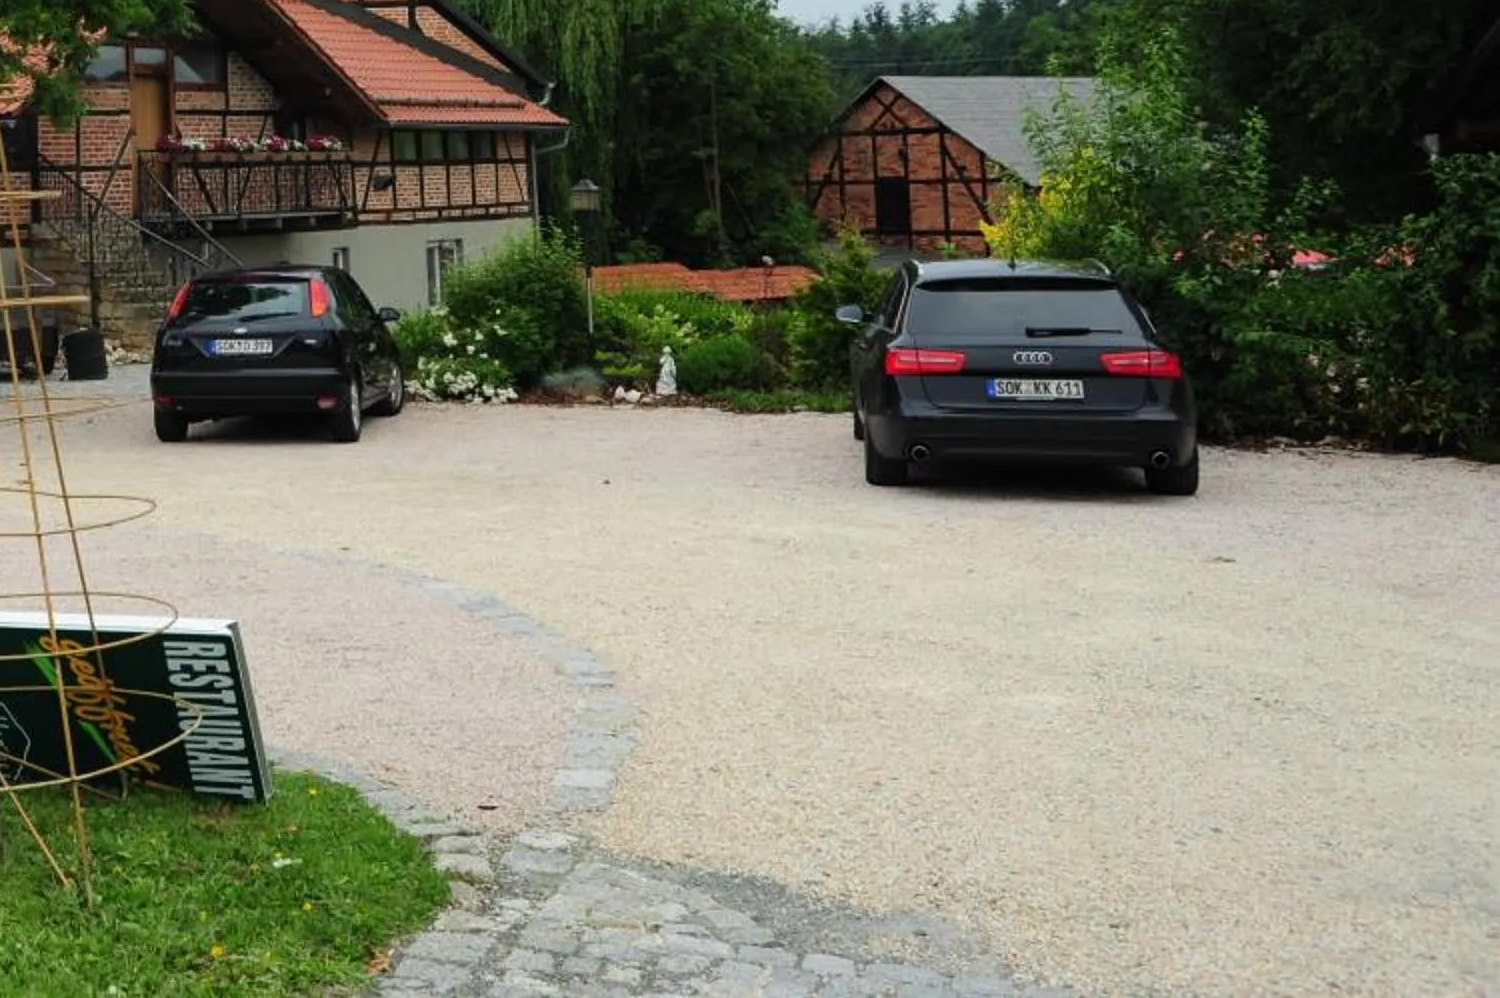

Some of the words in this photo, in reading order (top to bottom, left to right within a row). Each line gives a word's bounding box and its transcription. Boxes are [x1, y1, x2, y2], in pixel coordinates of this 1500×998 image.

[996, 381, 1024, 396] SOK
[1055, 381, 1082, 397] 611
[162, 640, 258, 799] RESTAURANT
